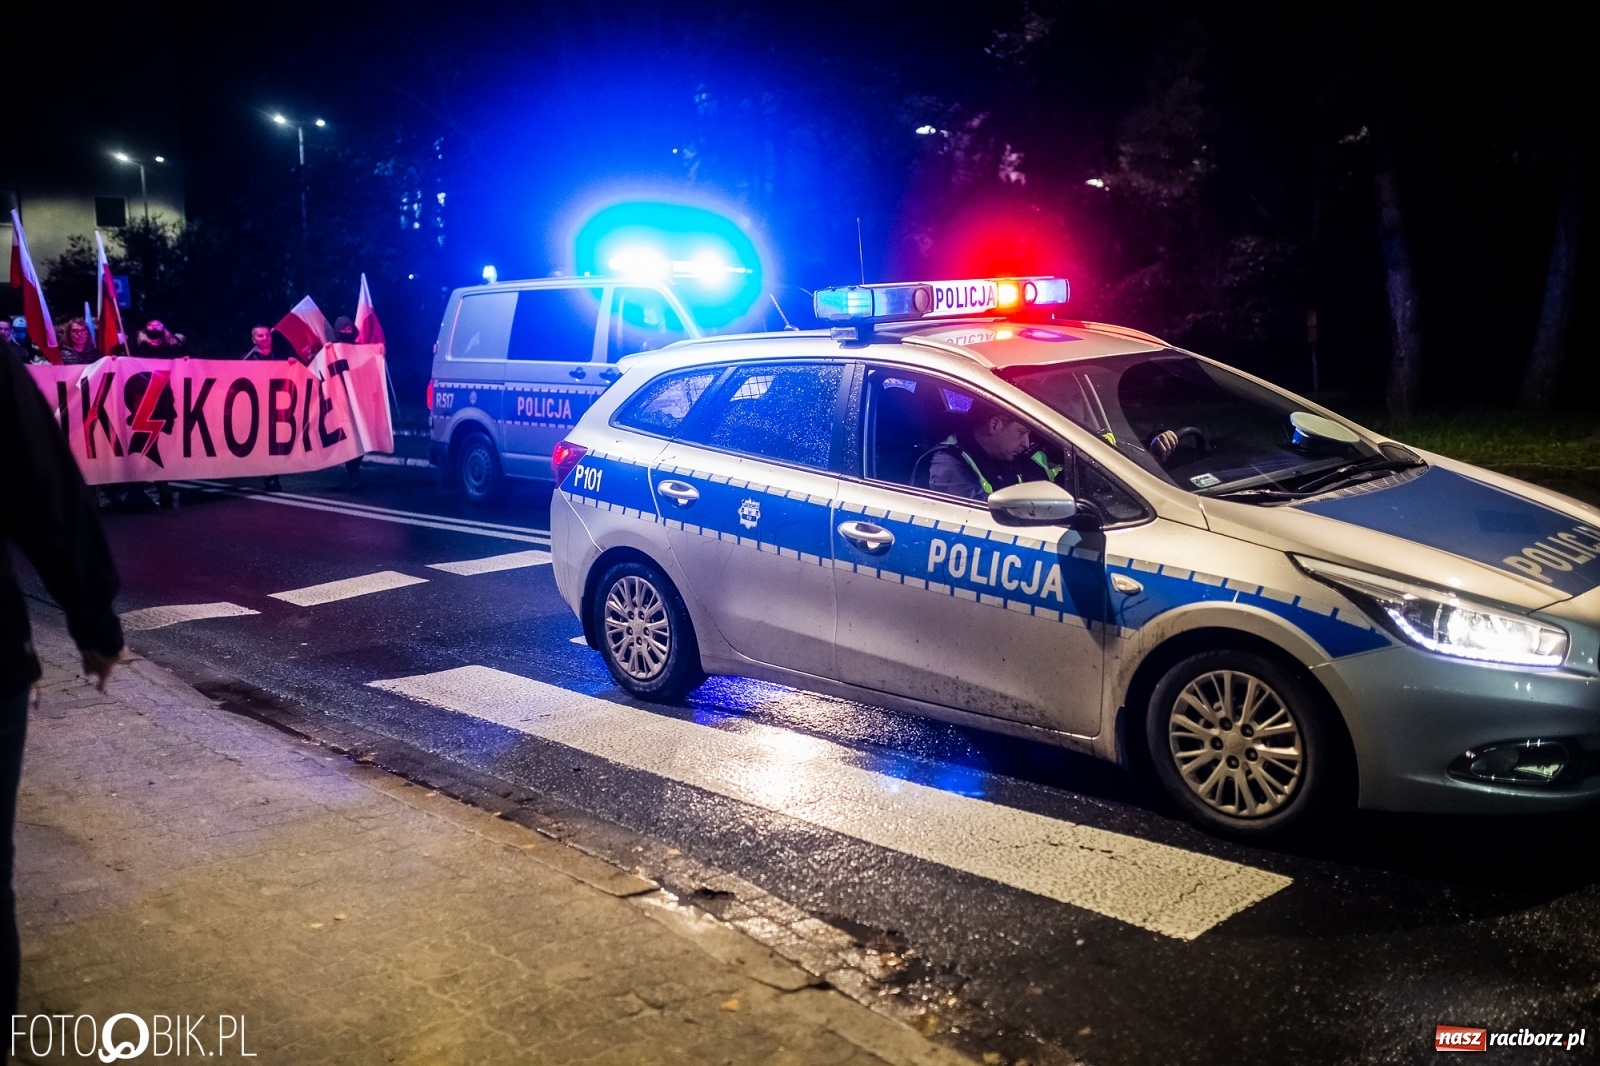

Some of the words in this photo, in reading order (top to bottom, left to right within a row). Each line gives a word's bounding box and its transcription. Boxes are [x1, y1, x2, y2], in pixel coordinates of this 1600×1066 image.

[935, 285, 995, 309] POLICJA
[182, 359, 350, 458] KOBIET
[436, 393, 454, 408] R517
[517, 396, 572, 419] POLICJA
[574, 464, 603, 492] P101
[927, 538, 1064, 602] POLICJA
